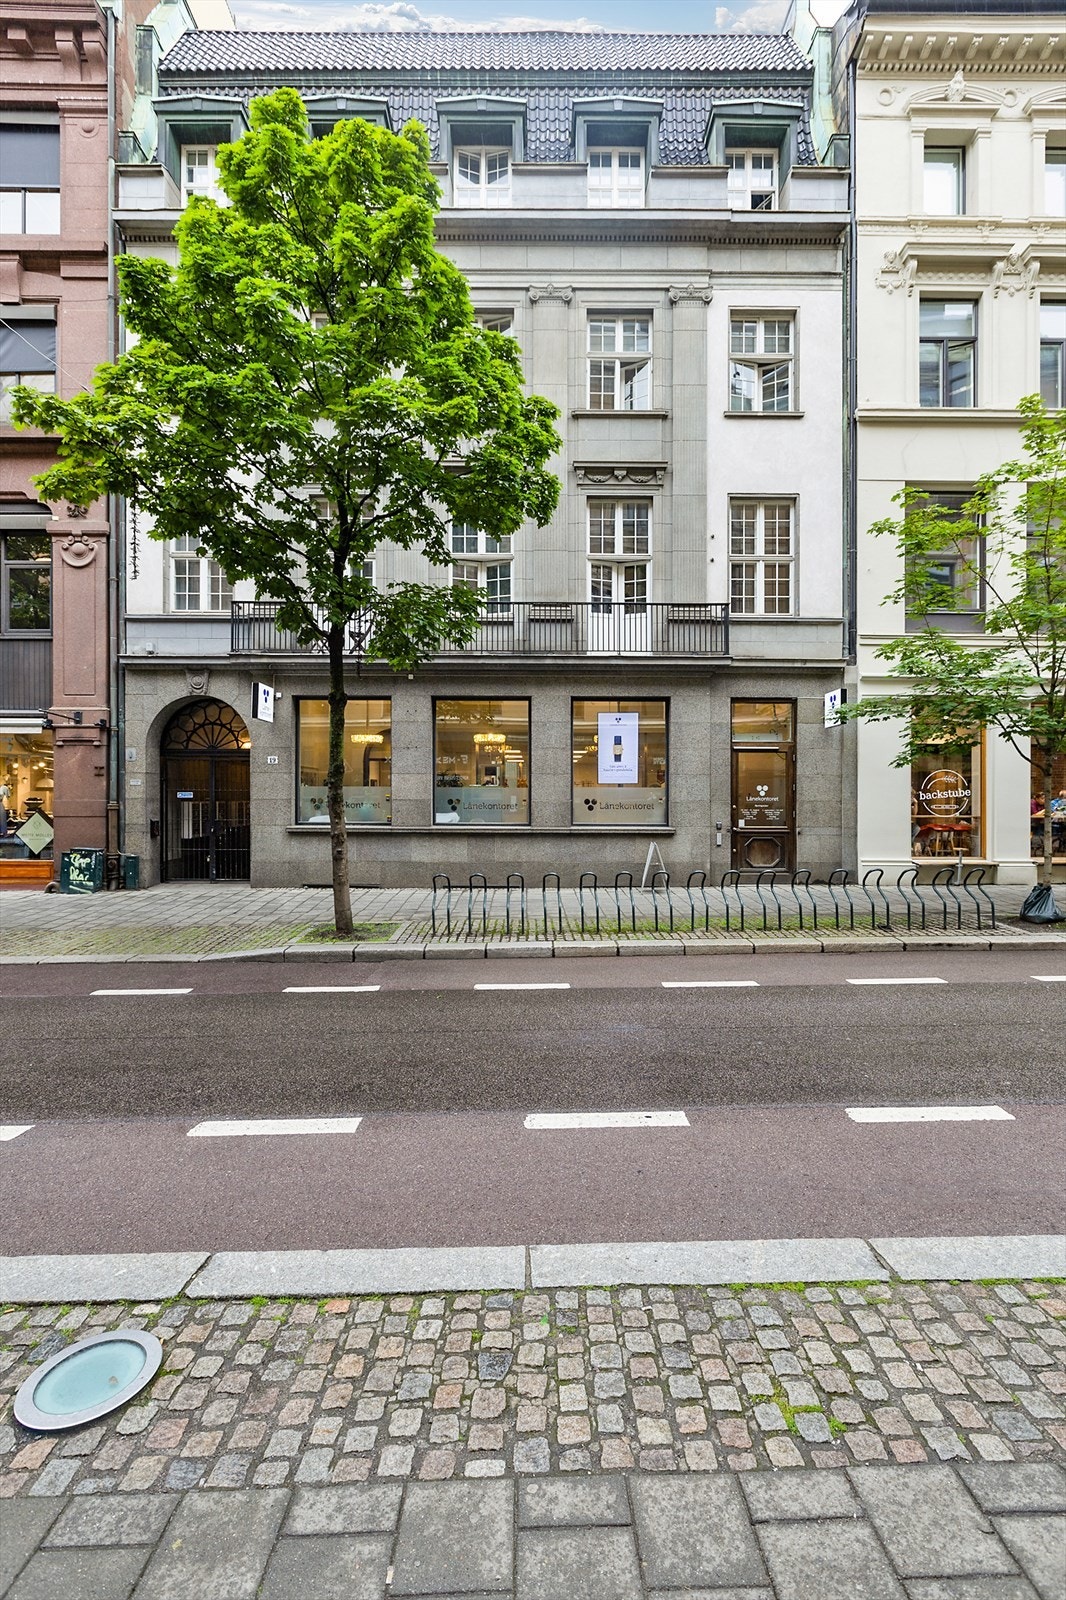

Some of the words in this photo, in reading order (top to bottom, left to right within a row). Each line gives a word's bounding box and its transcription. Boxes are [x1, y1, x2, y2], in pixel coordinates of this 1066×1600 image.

[919, 788, 971, 800] backstube
[463, 802, 518, 810] Lånekontoret
[599, 802, 655, 810] Lånekontoret
